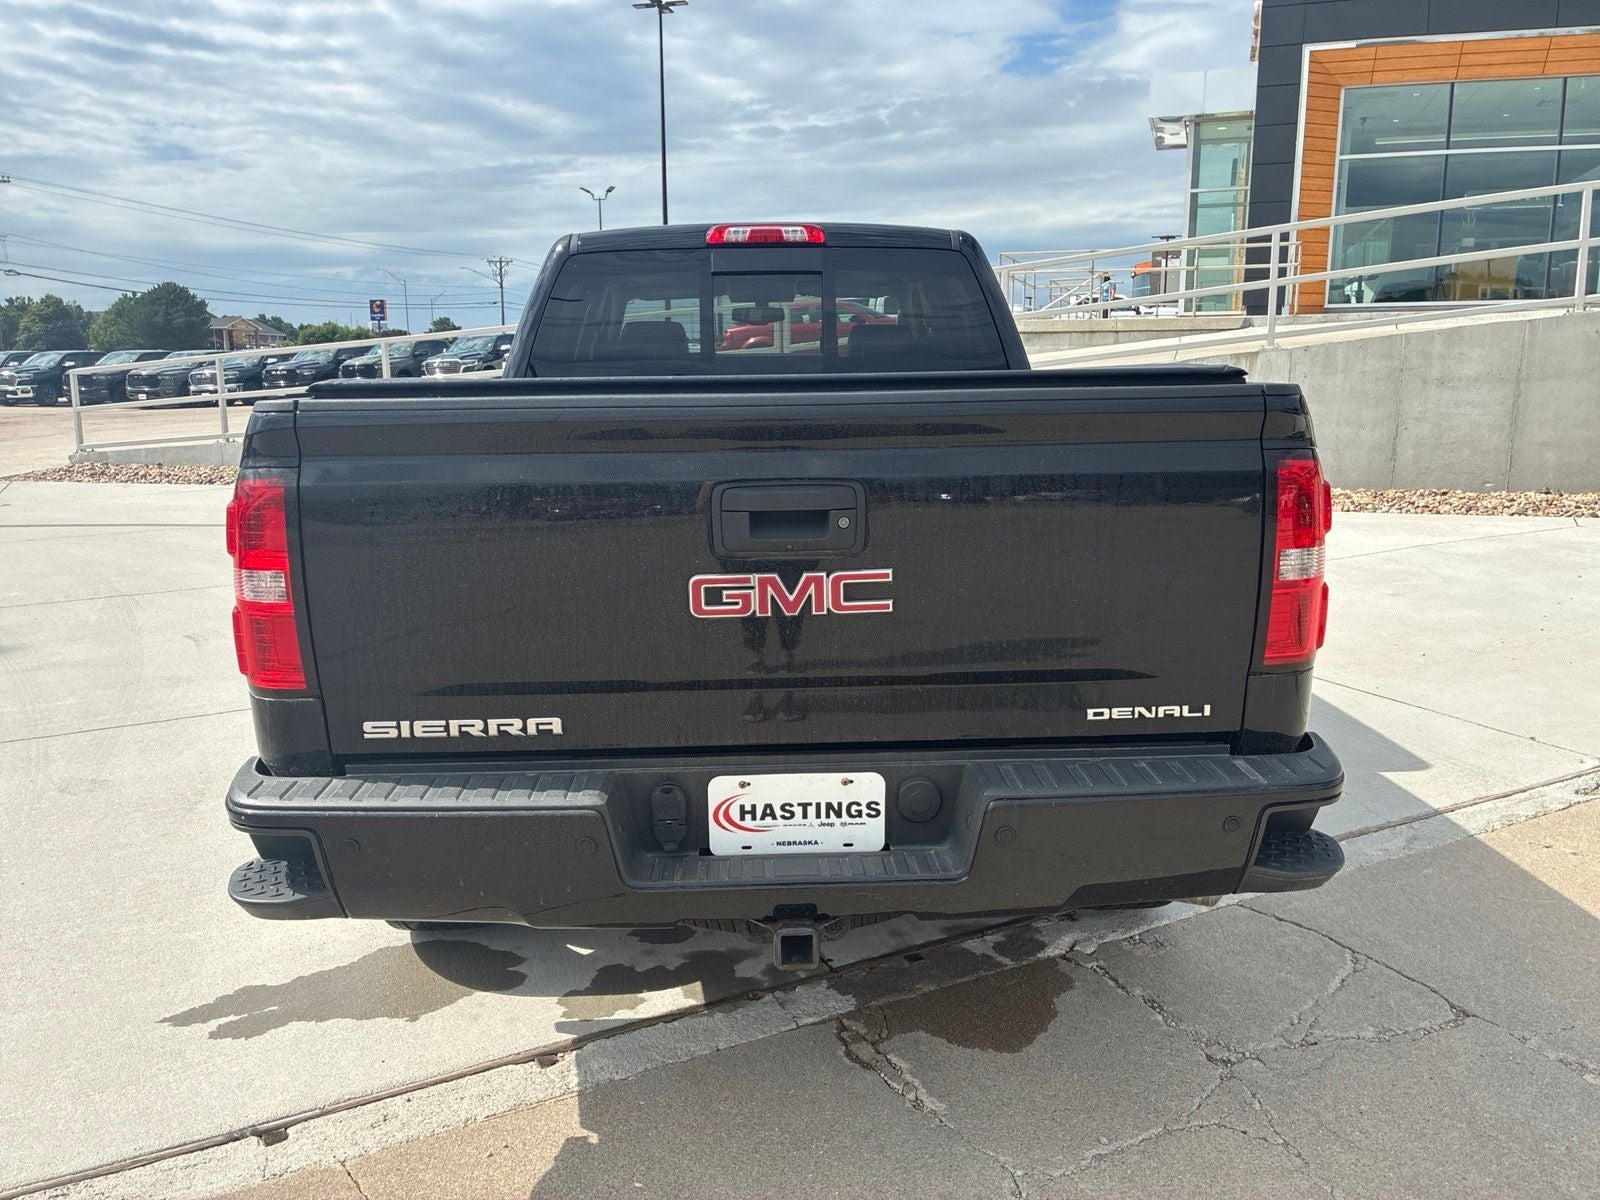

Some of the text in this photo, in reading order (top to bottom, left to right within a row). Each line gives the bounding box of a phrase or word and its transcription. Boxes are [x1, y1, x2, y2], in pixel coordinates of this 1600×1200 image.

[688, 568, 893, 618] GMC
[1086, 704, 1211, 720] DENALI
[362, 717, 563, 739] SIERRA
[739, 800, 882, 822] HASTINGS
